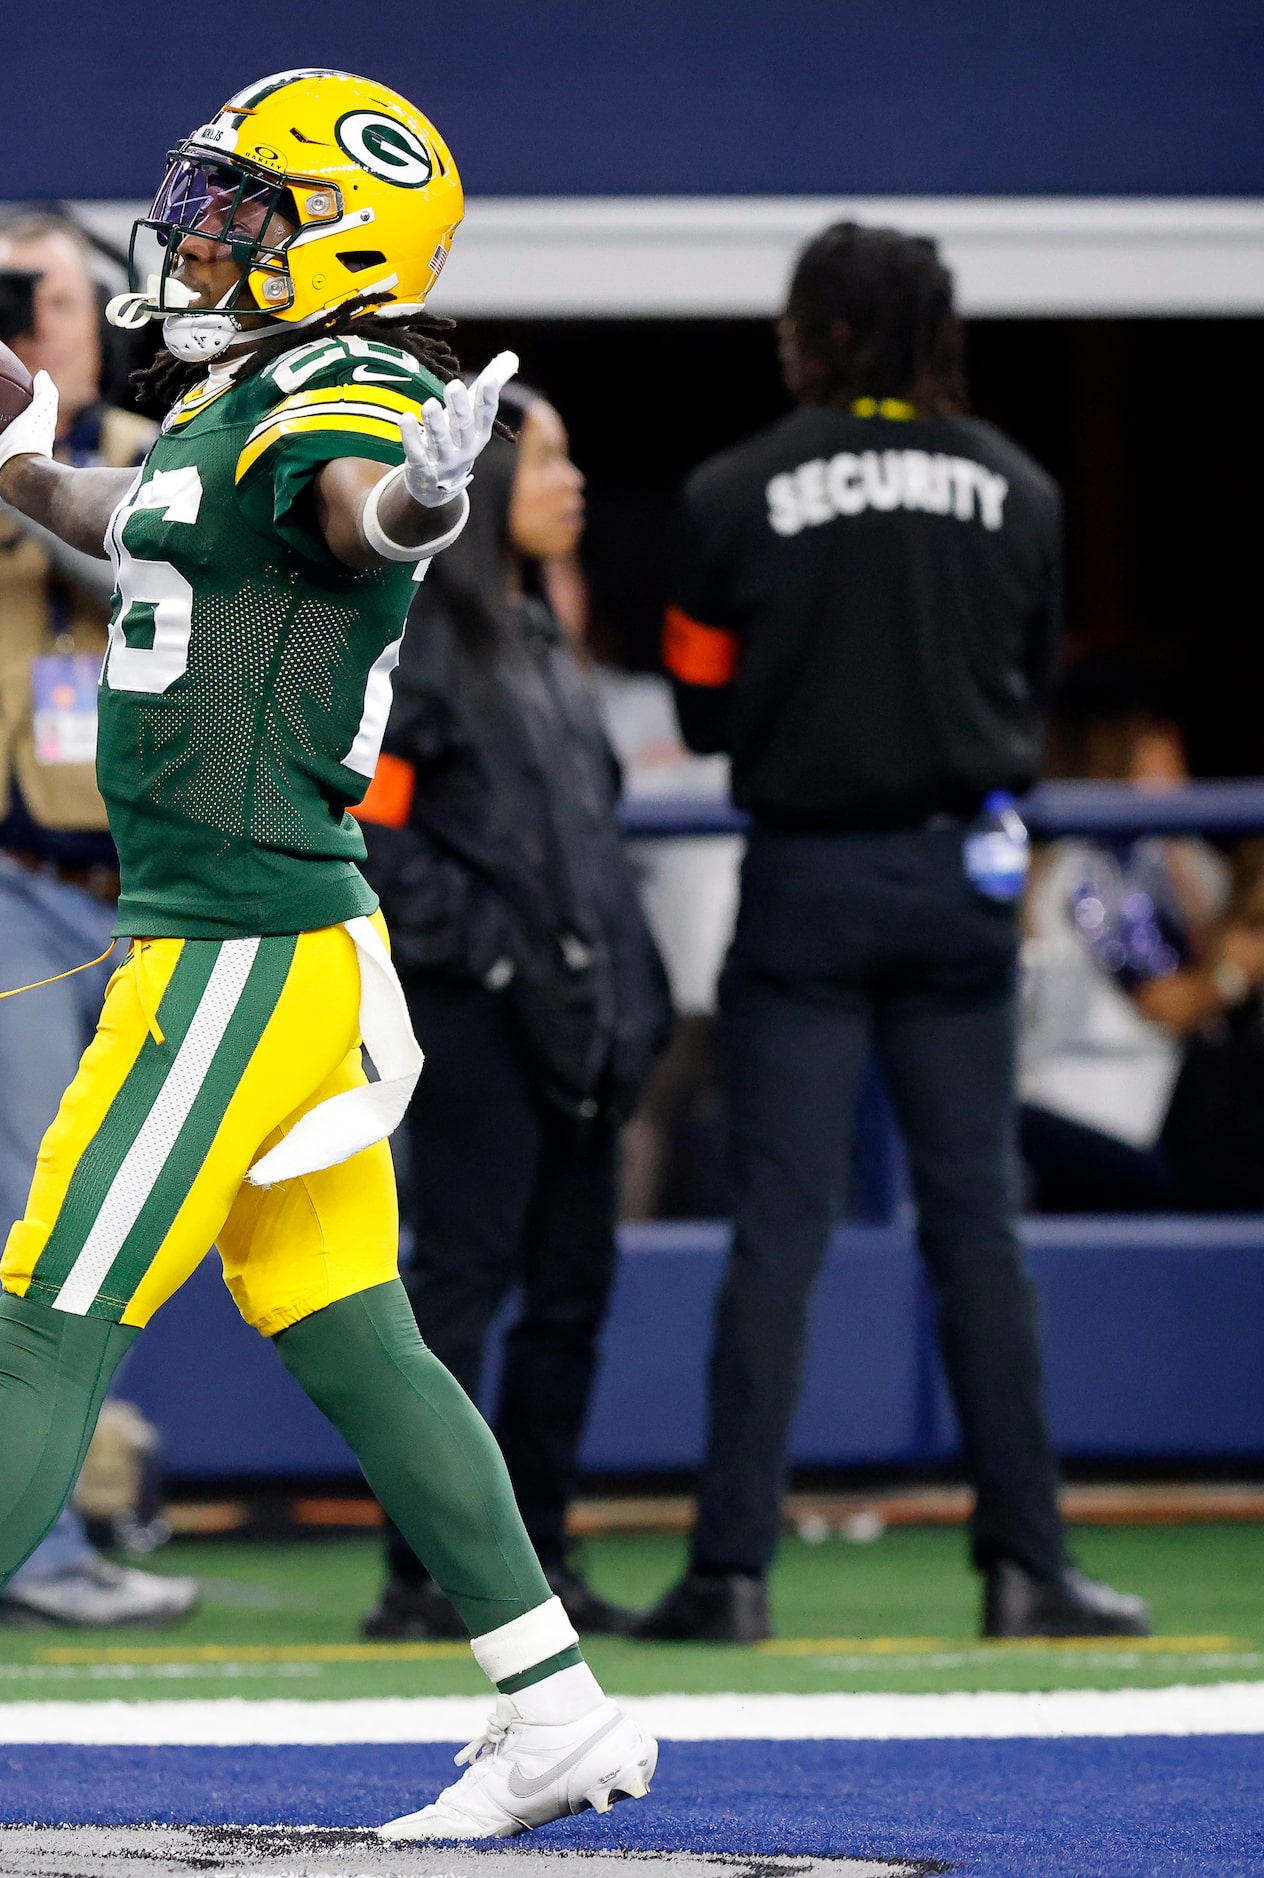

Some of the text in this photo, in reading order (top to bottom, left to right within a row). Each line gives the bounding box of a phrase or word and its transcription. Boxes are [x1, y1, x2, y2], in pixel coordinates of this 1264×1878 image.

[244, 151, 282, 171] OAKLEY
[765, 448, 1009, 537] SECURITY
[98, 464, 204, 694] 6
